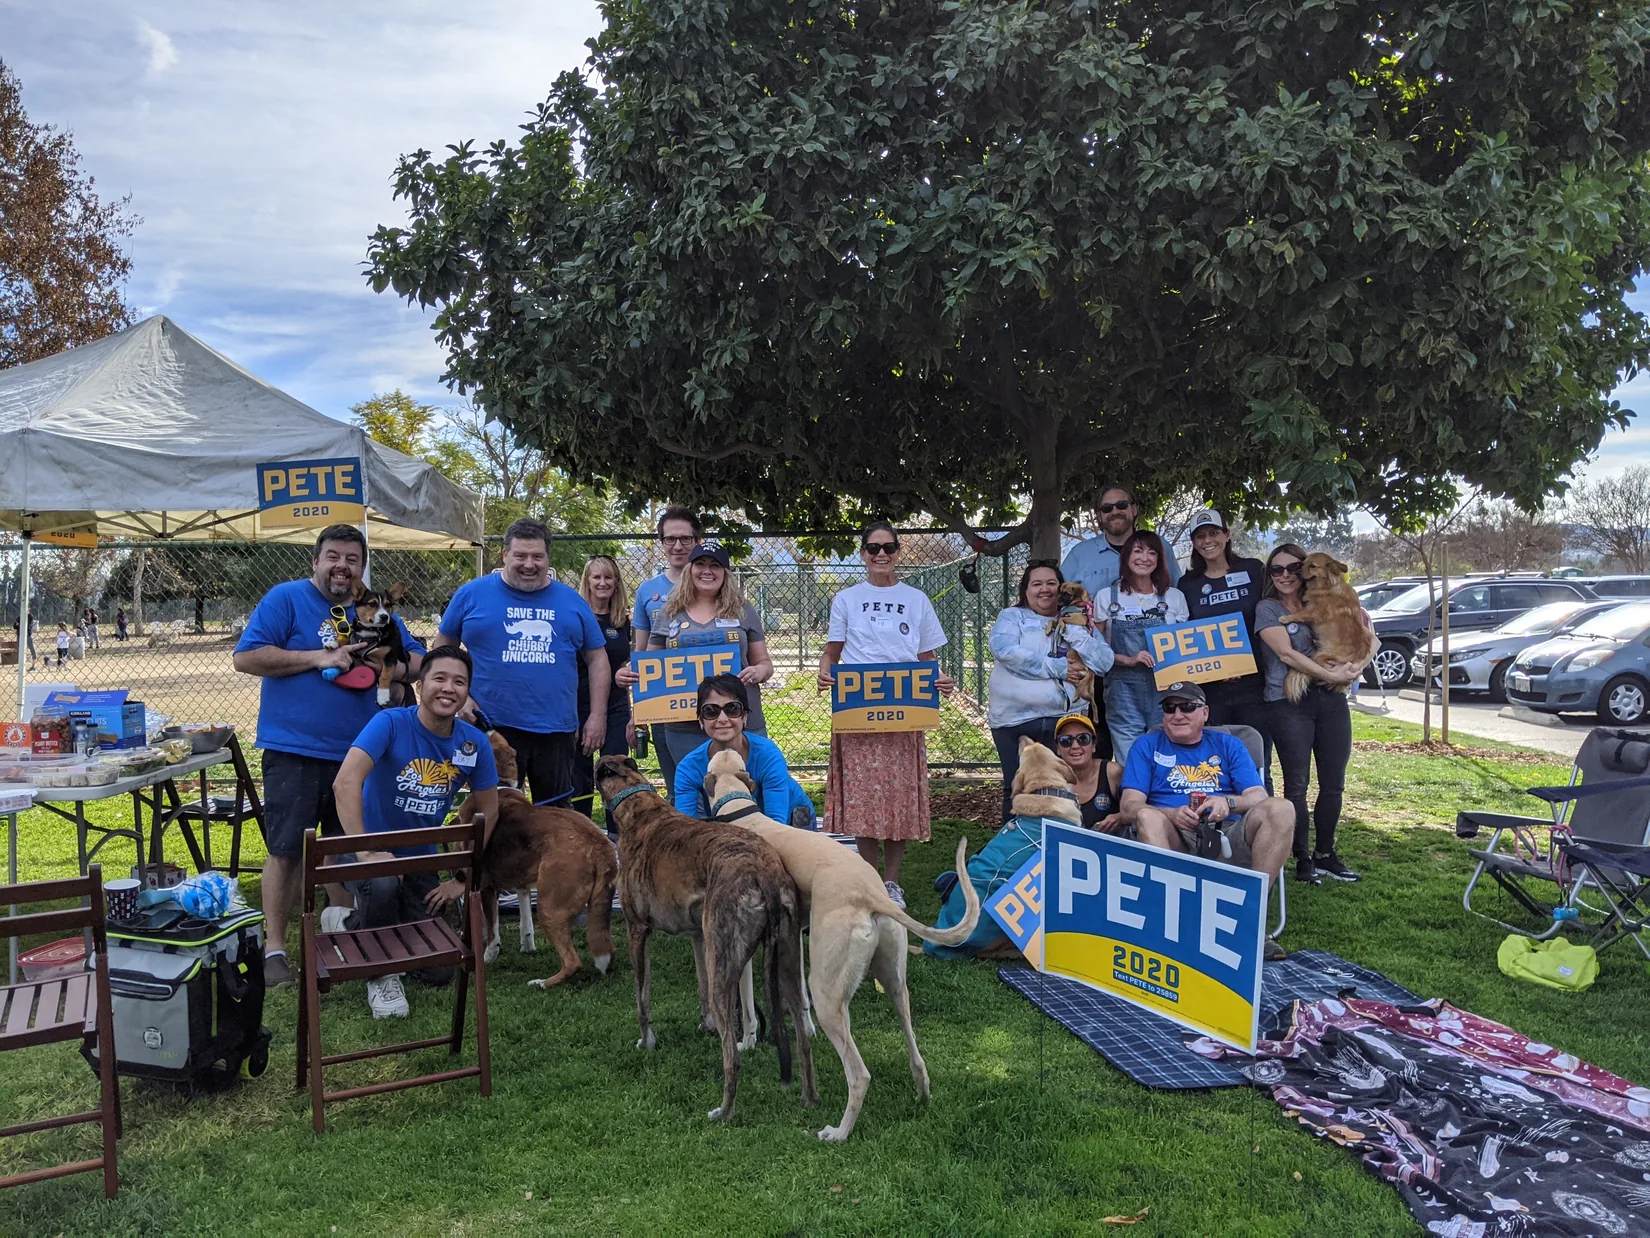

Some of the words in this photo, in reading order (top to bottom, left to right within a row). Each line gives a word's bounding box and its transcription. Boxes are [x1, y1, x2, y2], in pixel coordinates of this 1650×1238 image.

[263, 464, 356, 502] PETE
[293, 506, 329, 518] 2020
[1211, 590, 1237, 603] PETE
[506, 607, 534, 619] SAVE
[535, 608, 556, 621] THE
[862, 602, 905, 615] PETE
[508, 639, 551, 652] CHUBBY
[1152, 619, 1244, 663] PETE
[502, 650, 556, 664] UNICORNS
[1186, 660, 1222, 675] 2020
[837, 668, 933, 704] PETE
[669, 698, 698, 710] 202
[867, 710, 905, 721] 2020
[396, 767, 423, 783] Los
[398, 780, 448, 798] Angeles
[407, 800, 436, 813] PETE
[994, 861, 1042, 938] PE
[1059, 842, 1247, 971] PETE
[1113, 945, 1179, 988] 2020
[1114, 970, 1129, 982] Text
[1129, 976, 1147, 989] PETE
[1148, 984, 1156, 992] to
[1156, 987, 1178, 1001] 25859
